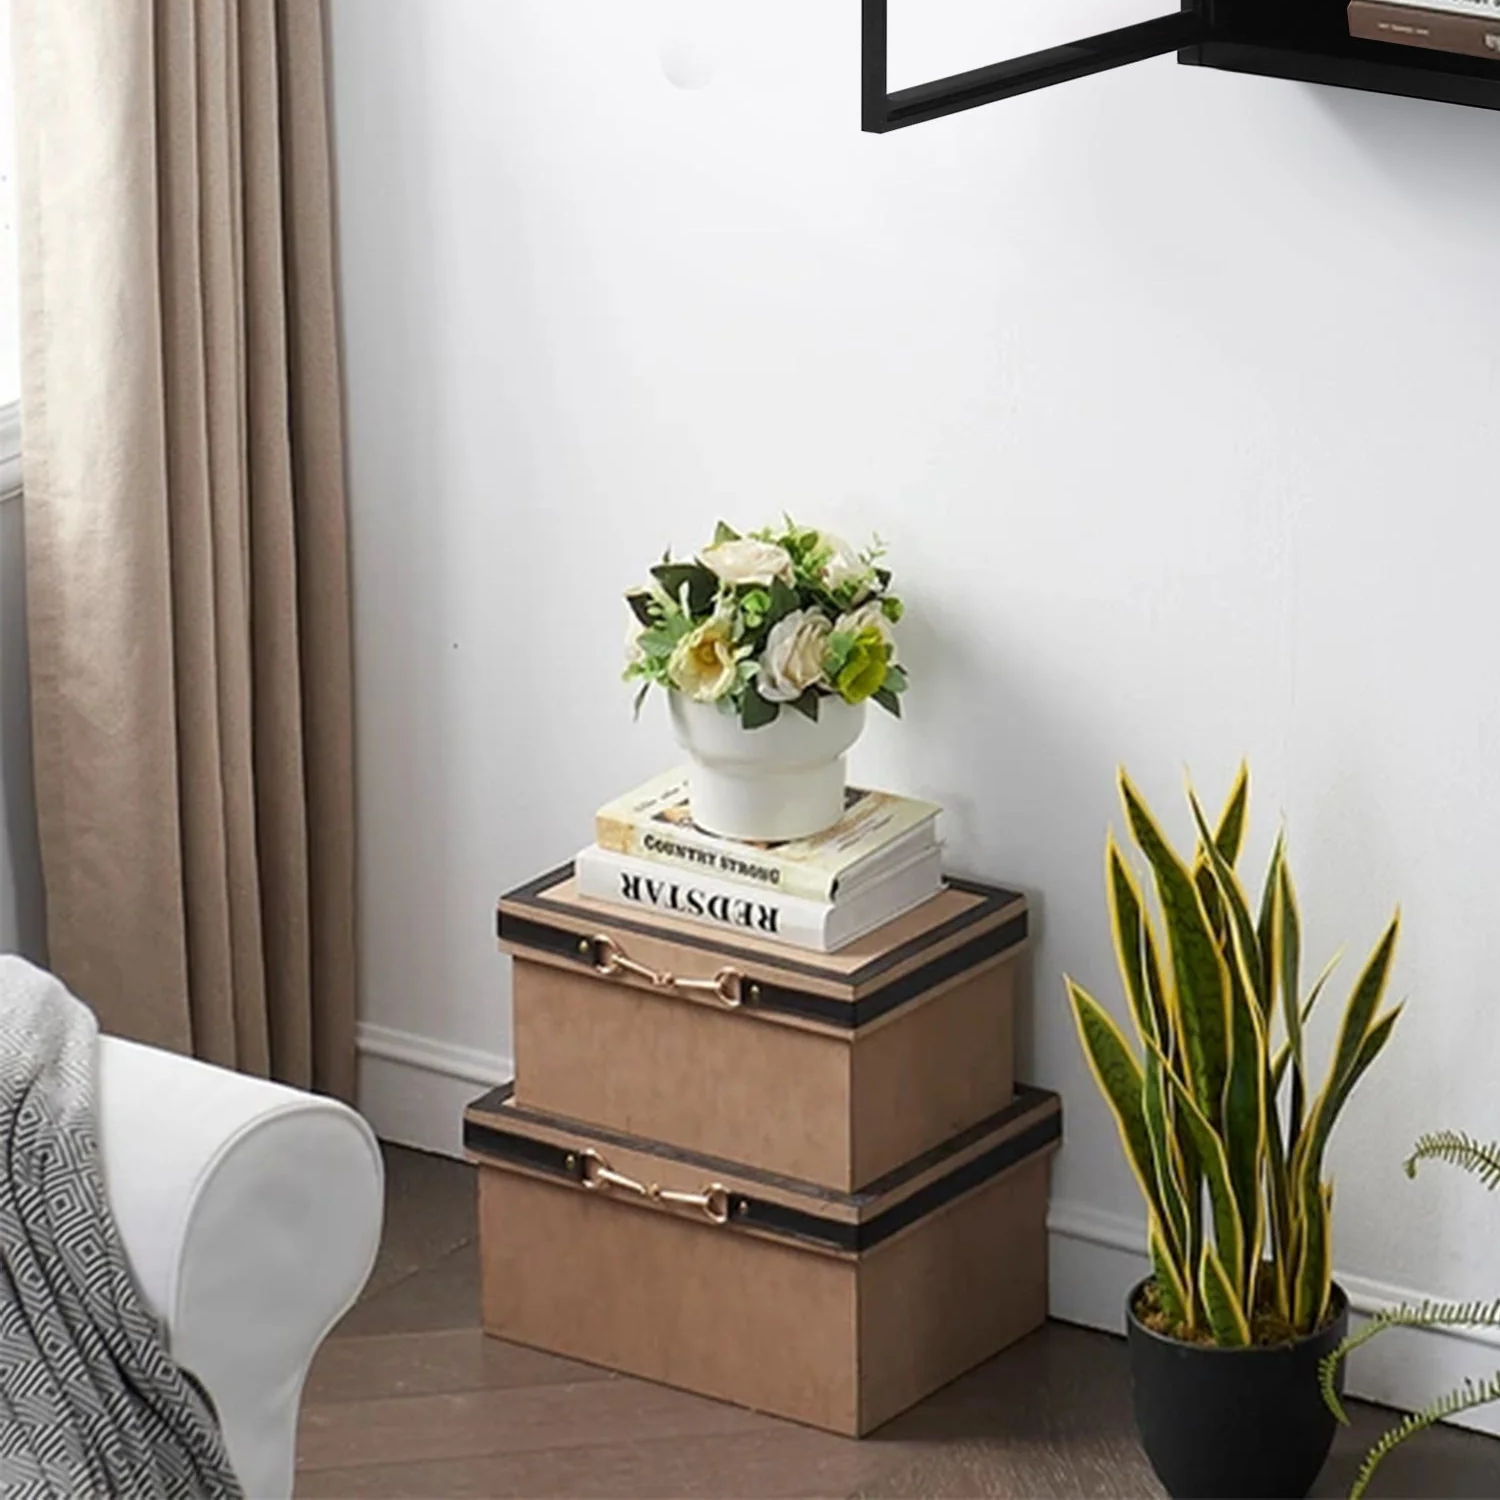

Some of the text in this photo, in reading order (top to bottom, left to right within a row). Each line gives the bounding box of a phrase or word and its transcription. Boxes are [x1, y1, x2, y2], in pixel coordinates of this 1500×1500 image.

[643, 834, 780, 884] COUNTRY STRONG
[621, 872, 780, 933] REDSTAR
